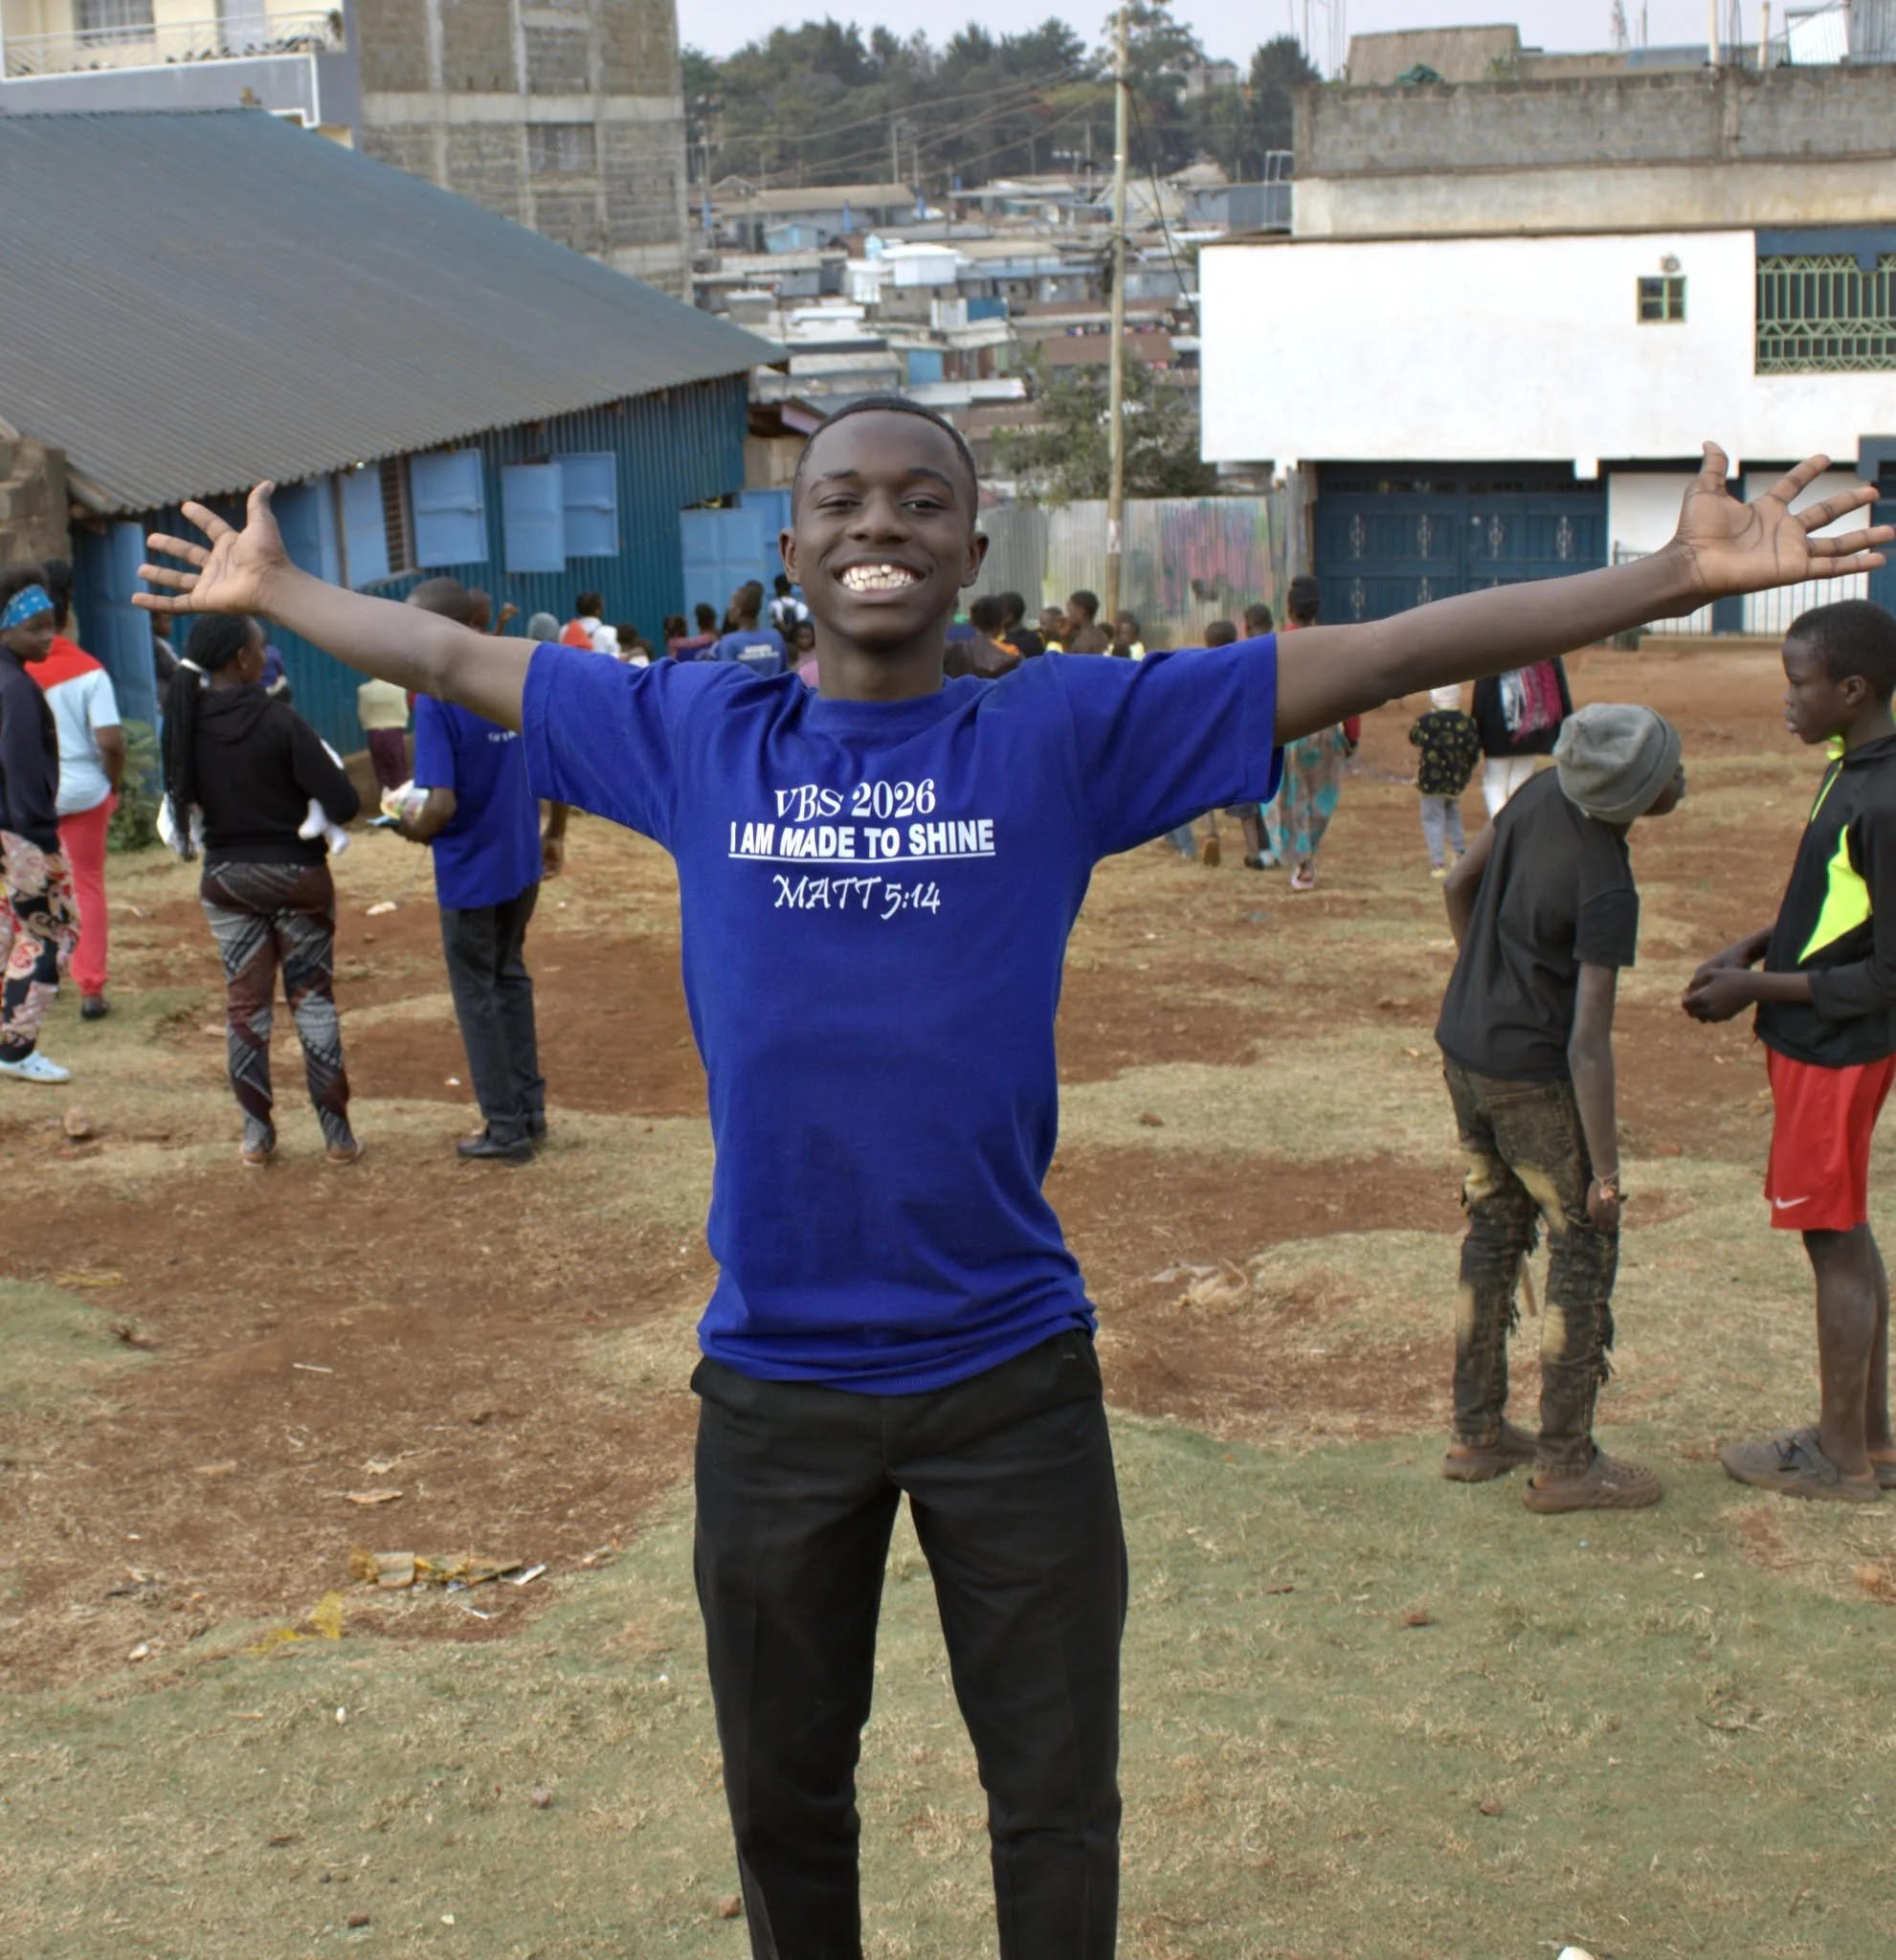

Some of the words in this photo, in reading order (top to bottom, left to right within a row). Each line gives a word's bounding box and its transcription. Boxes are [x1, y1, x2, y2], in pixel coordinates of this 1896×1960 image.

[774, 784, 844, 822] VBS
[851, 778, 936, 819] 2026
[729, 821, 737, 853] I
[740, 822, 775, 856] AM
[779, 826, 856, 858] MADE
[863, 827, 901, 858] TO
[908, 818, 995, 856] SHINE
[772, 874, 881, 909] MATT
[880, 881, 941, 920] 5:14
